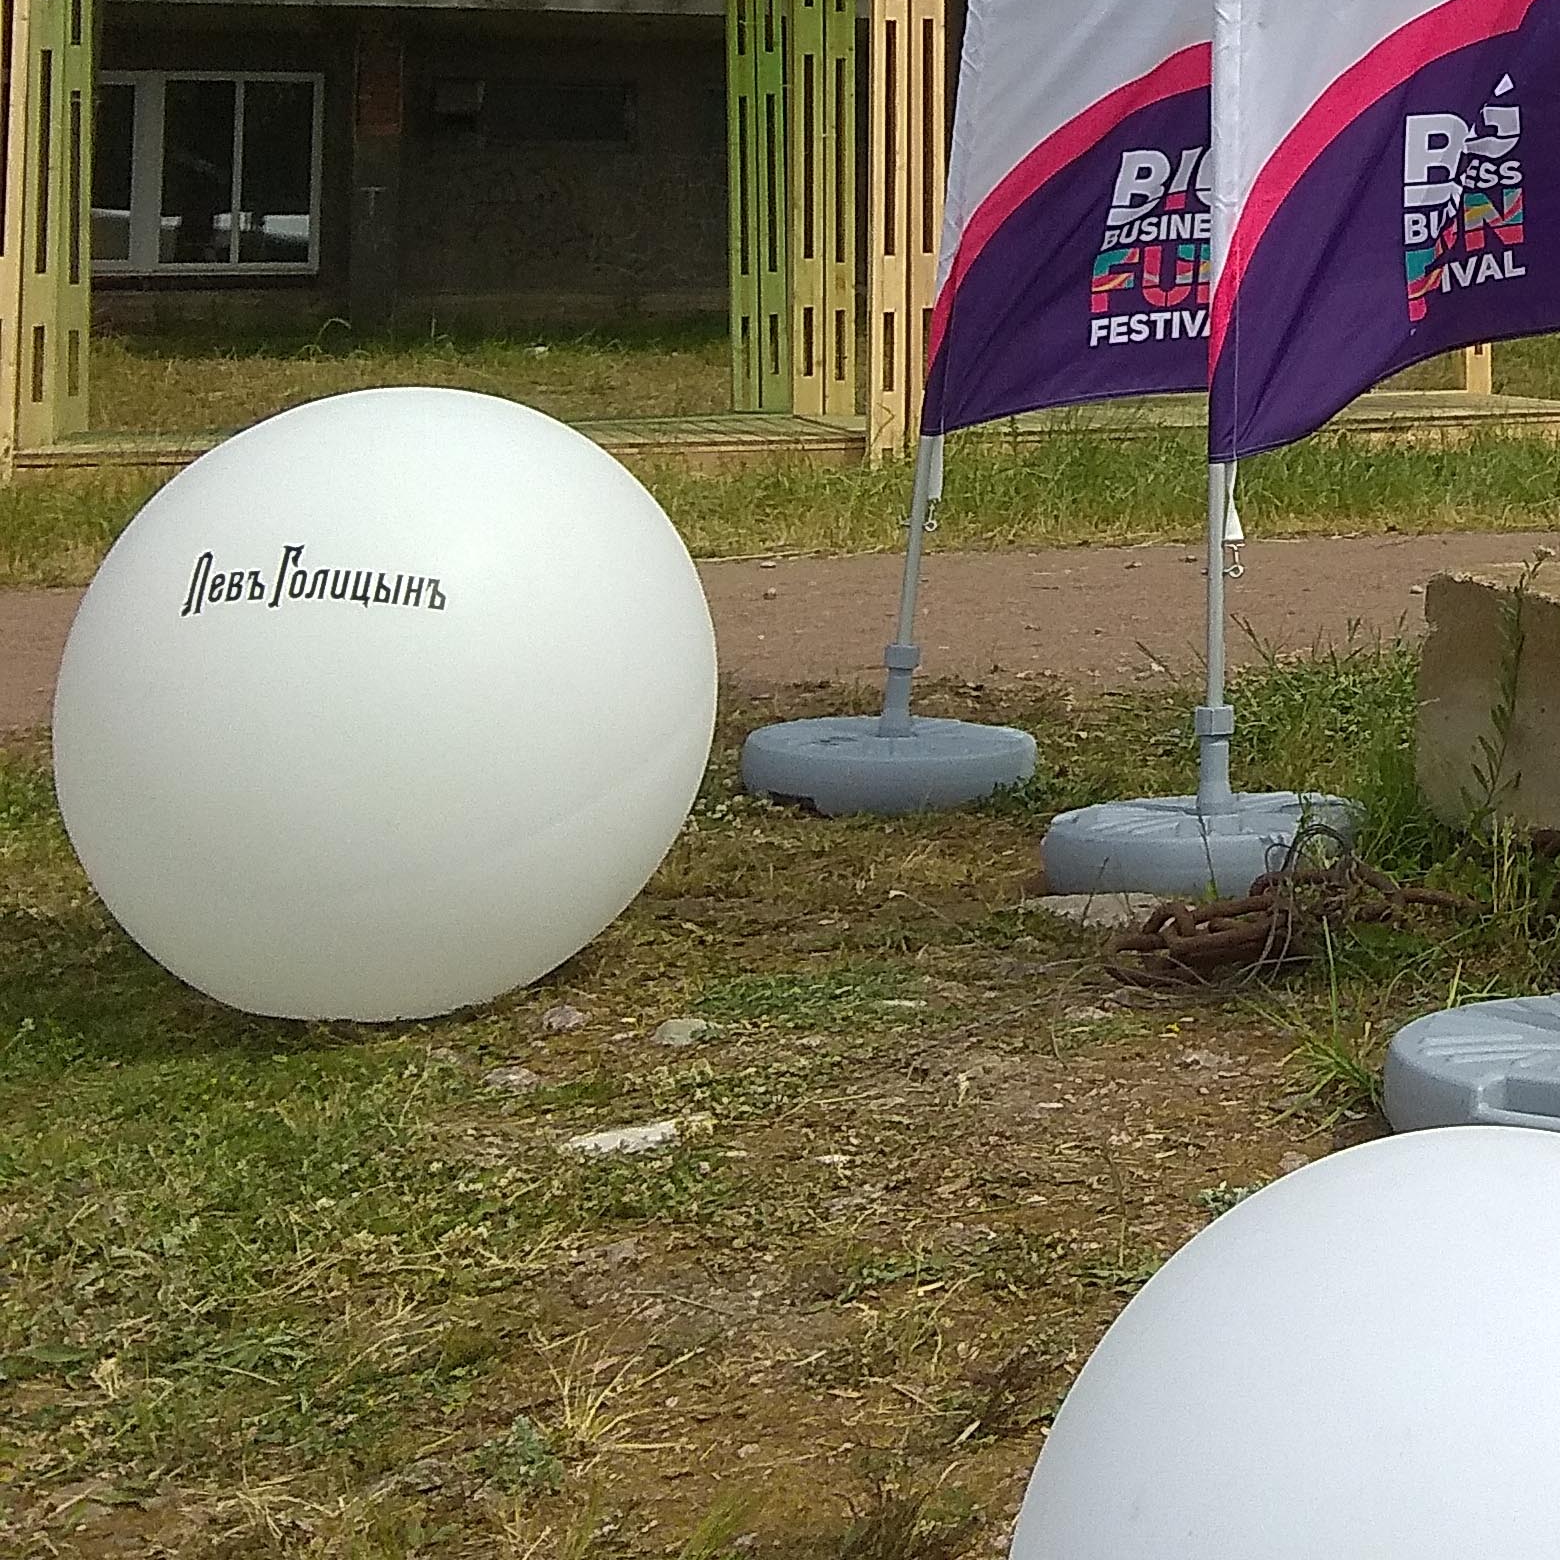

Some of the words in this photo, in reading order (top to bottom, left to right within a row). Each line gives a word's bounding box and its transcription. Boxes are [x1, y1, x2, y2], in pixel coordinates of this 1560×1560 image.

[1101, 212, 1212, 252] BUSINE
[1089, 309, 1211, 348] FESTIV
[179, 548, 266, 618] Левъ
[267, 543, 447, 612] Голицынъ
